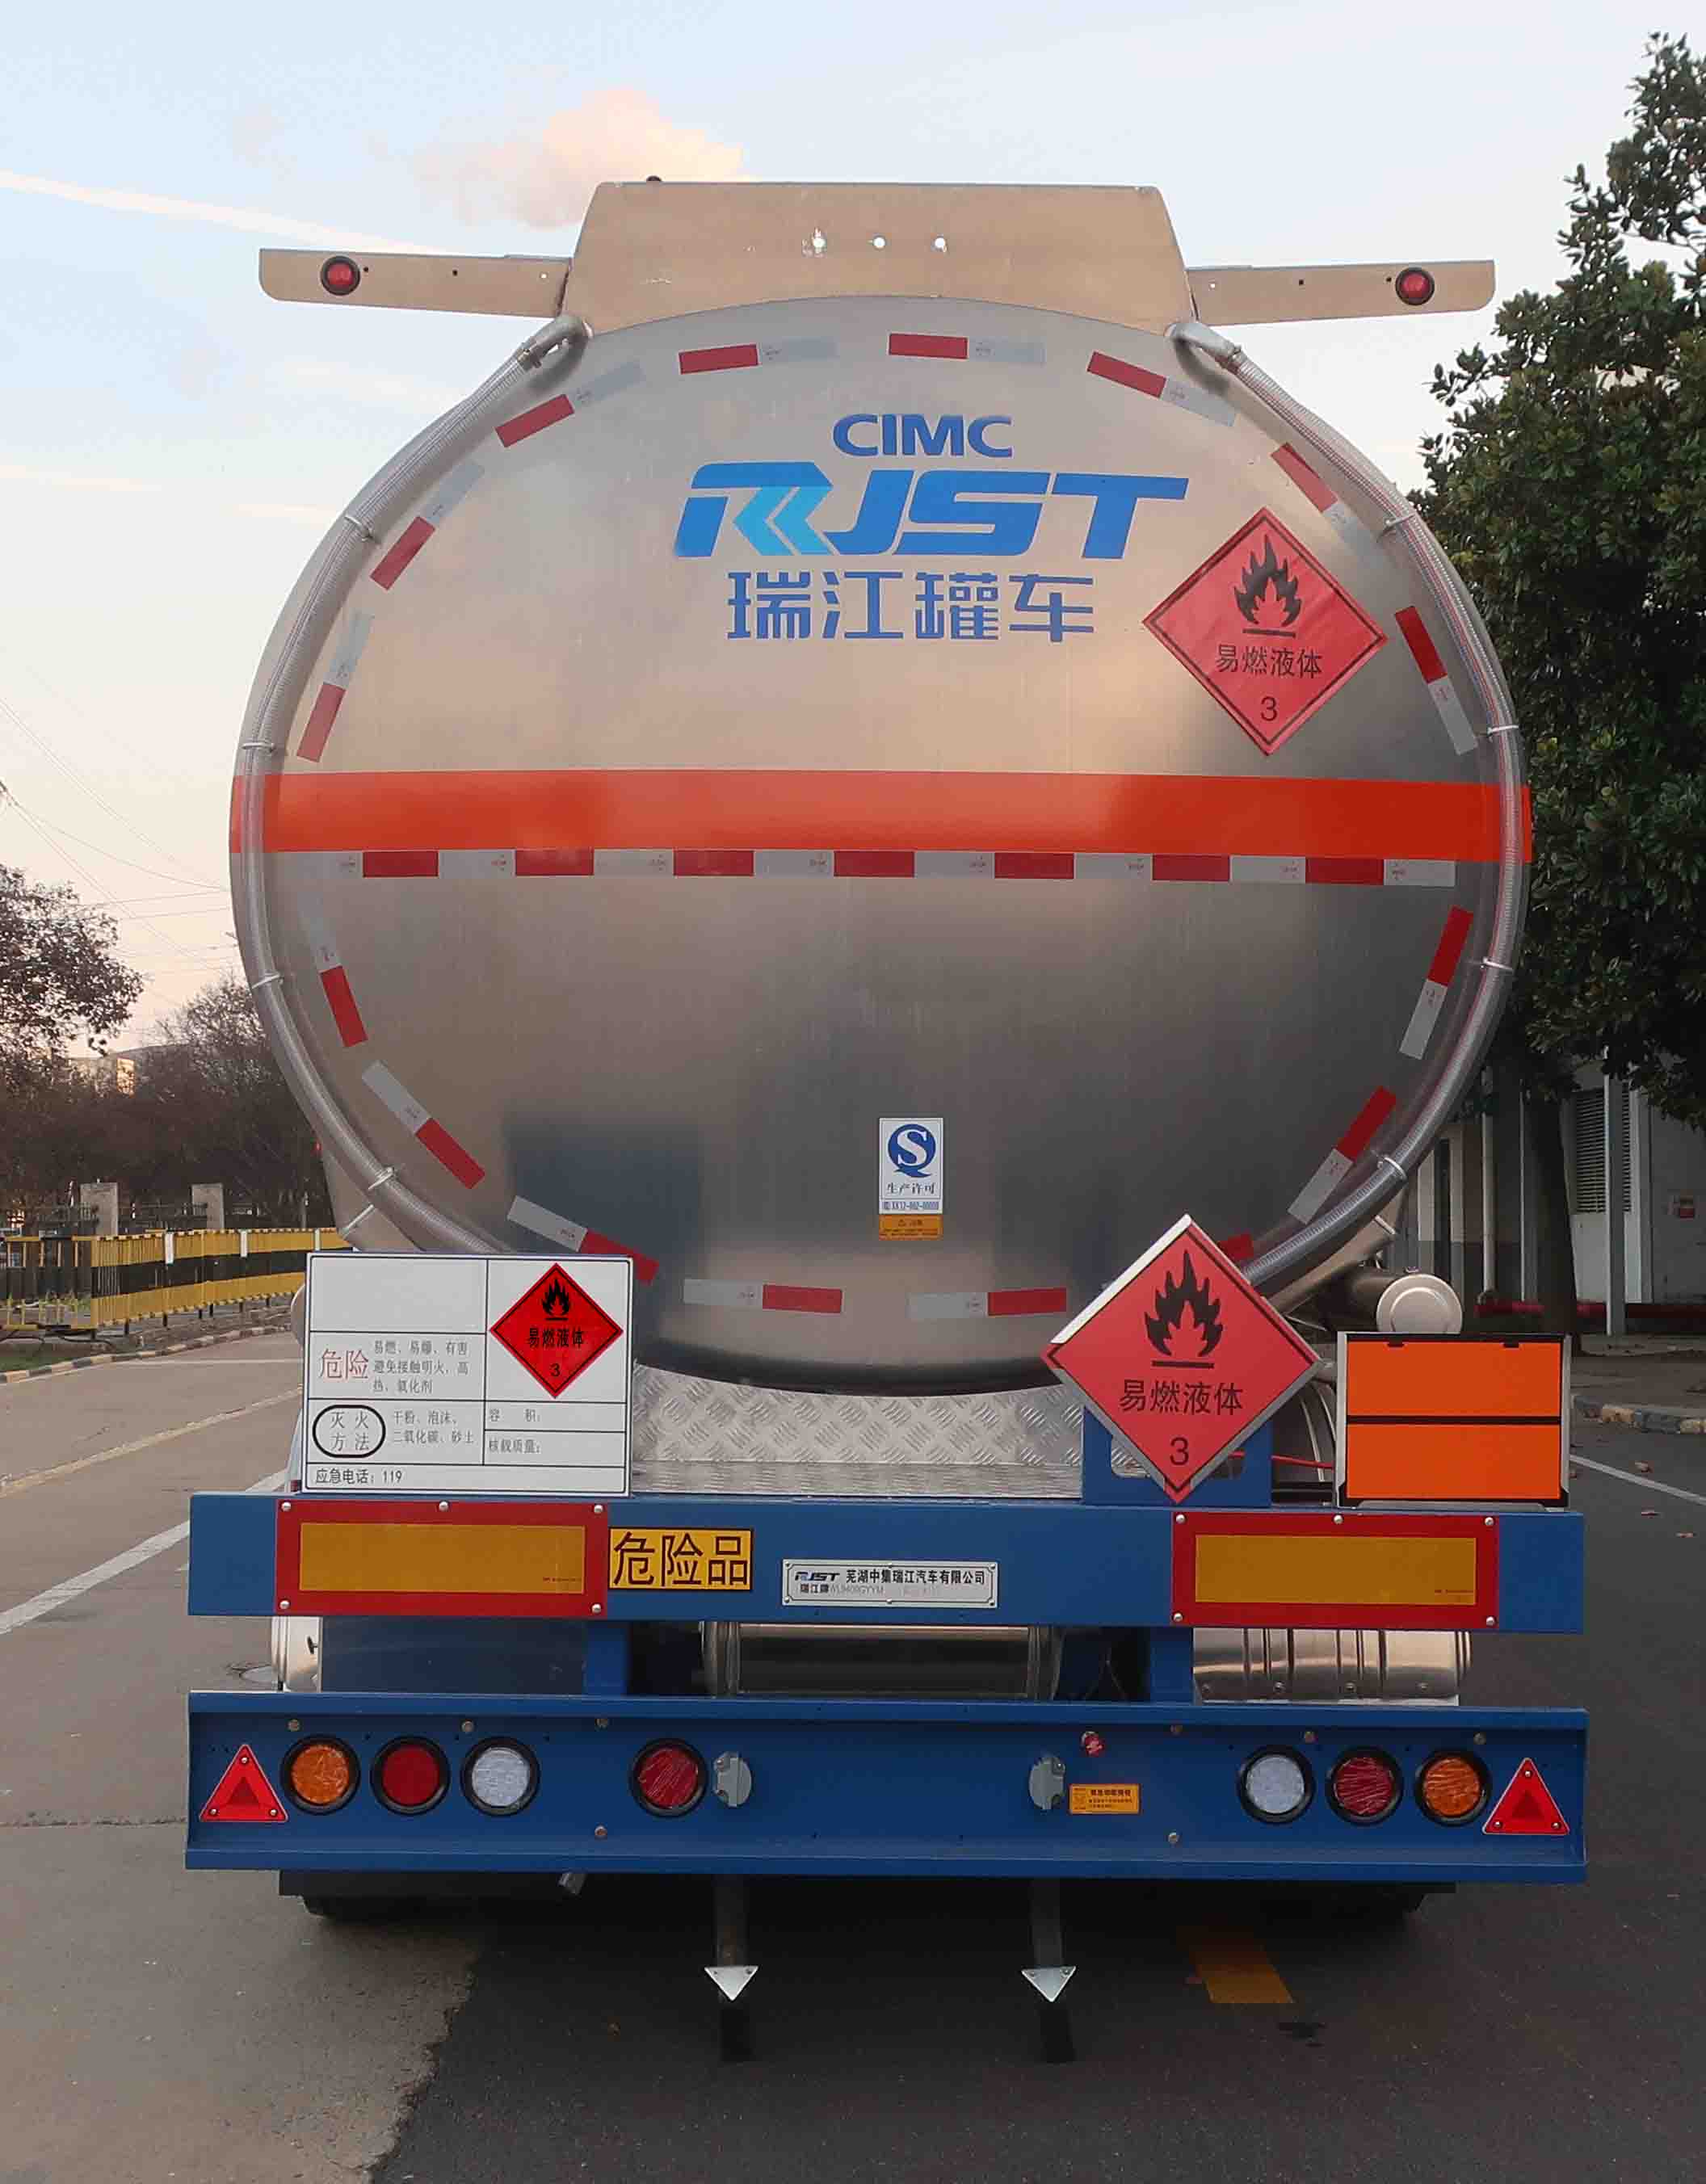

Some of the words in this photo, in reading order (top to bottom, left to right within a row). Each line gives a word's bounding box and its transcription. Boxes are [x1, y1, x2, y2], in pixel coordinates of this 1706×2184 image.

[833, 414, 1013, 458] CIMC
[726, 570, 1095, 643] 瑞江罐车
[1215, 643, 1322, 679] 易燃液体
[1260, 695, 1278, 721] 3
[526, 1327, 586, 1349] 易燃液体
[319, 1348, 369, 1380] 危险
[549, 1363, 561, 1377] 3
[1119, 1378, 1244, 1416] 易燃液体
[1170, 1436, 1189, 1466] 3
[612, 1531, 749, 1588] 危险品
[846, 1569, 985, 1586] 芜湖中集瑞江汽车有限公司
